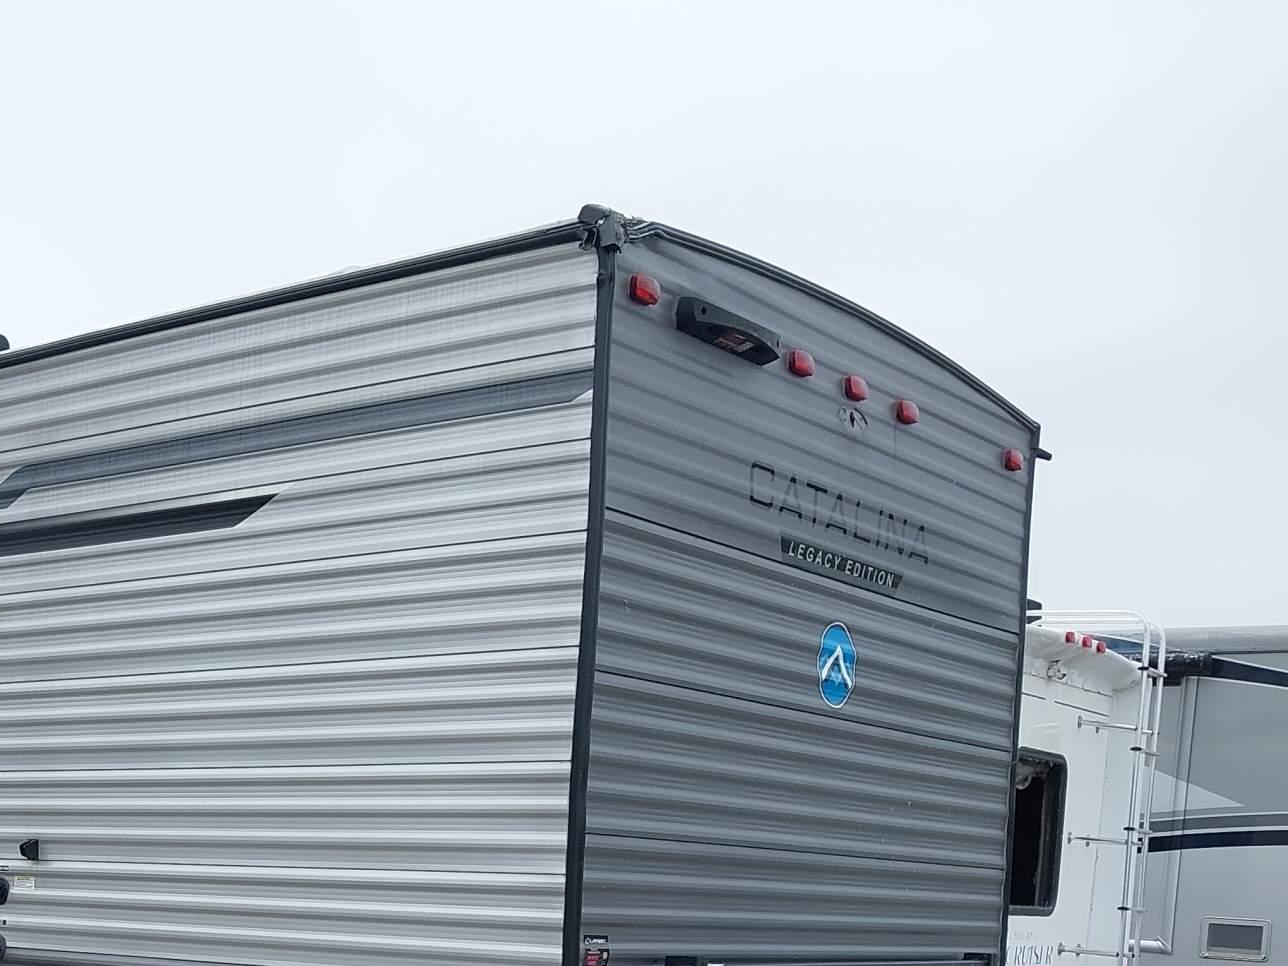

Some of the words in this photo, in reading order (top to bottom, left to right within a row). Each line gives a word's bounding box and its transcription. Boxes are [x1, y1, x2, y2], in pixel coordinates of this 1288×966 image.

[749, 461, 929, 566] CATALINA
[788, 540, 842, 570] LEGACY
[845, 559, 894, 588] EDITION
